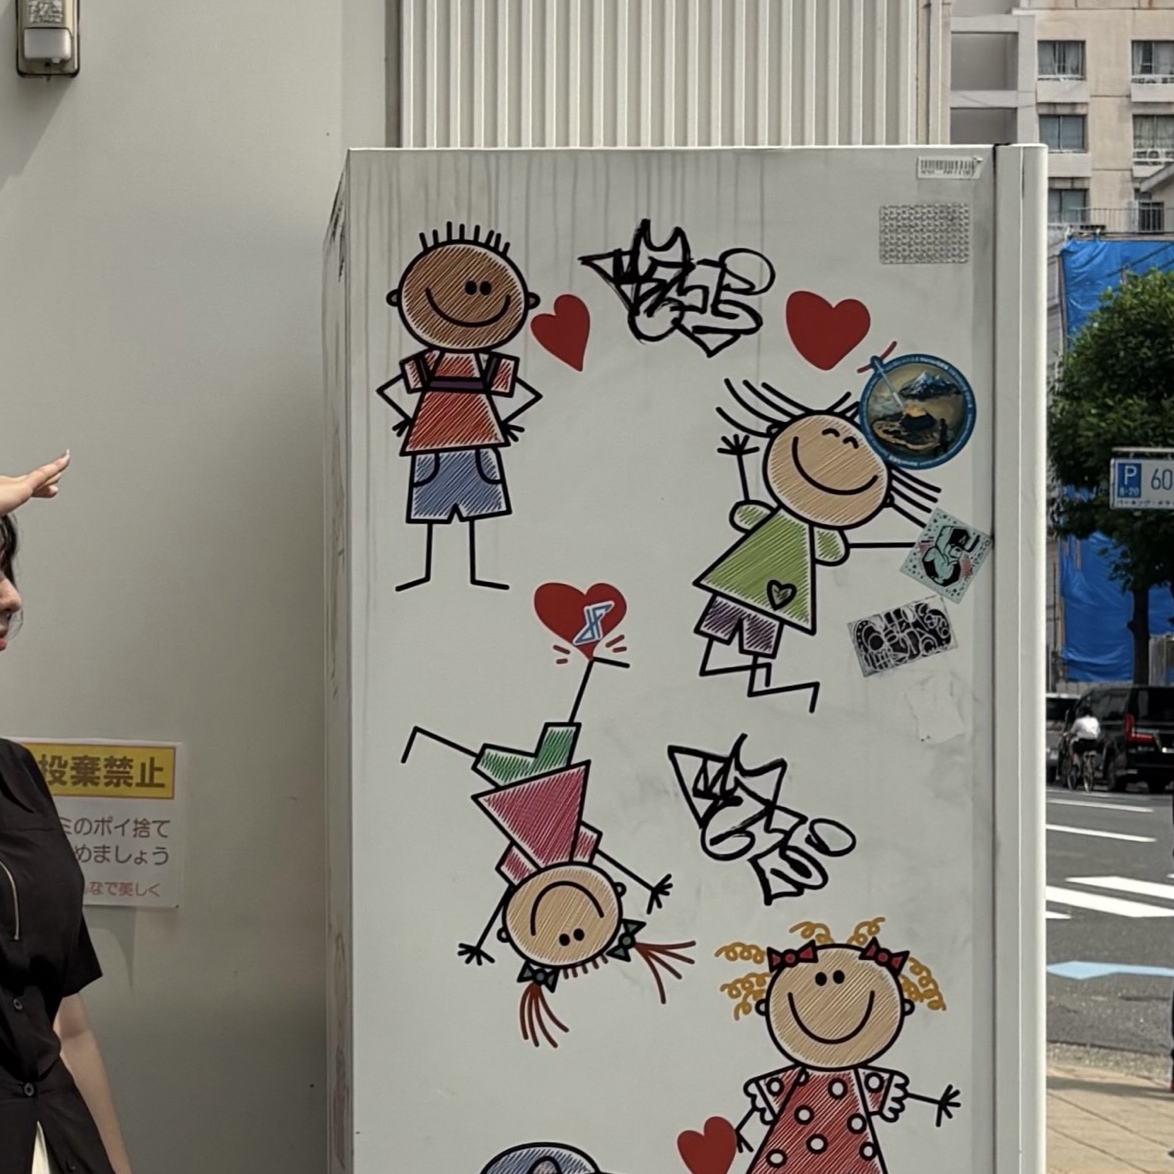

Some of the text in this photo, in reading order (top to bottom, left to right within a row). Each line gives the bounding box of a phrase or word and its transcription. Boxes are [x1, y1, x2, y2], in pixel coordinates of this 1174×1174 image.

[1125, 466, 1137, 485] P
[1151, 469, 1173, 490] 60
[38, 754, 165, 788] 投棄禁止
